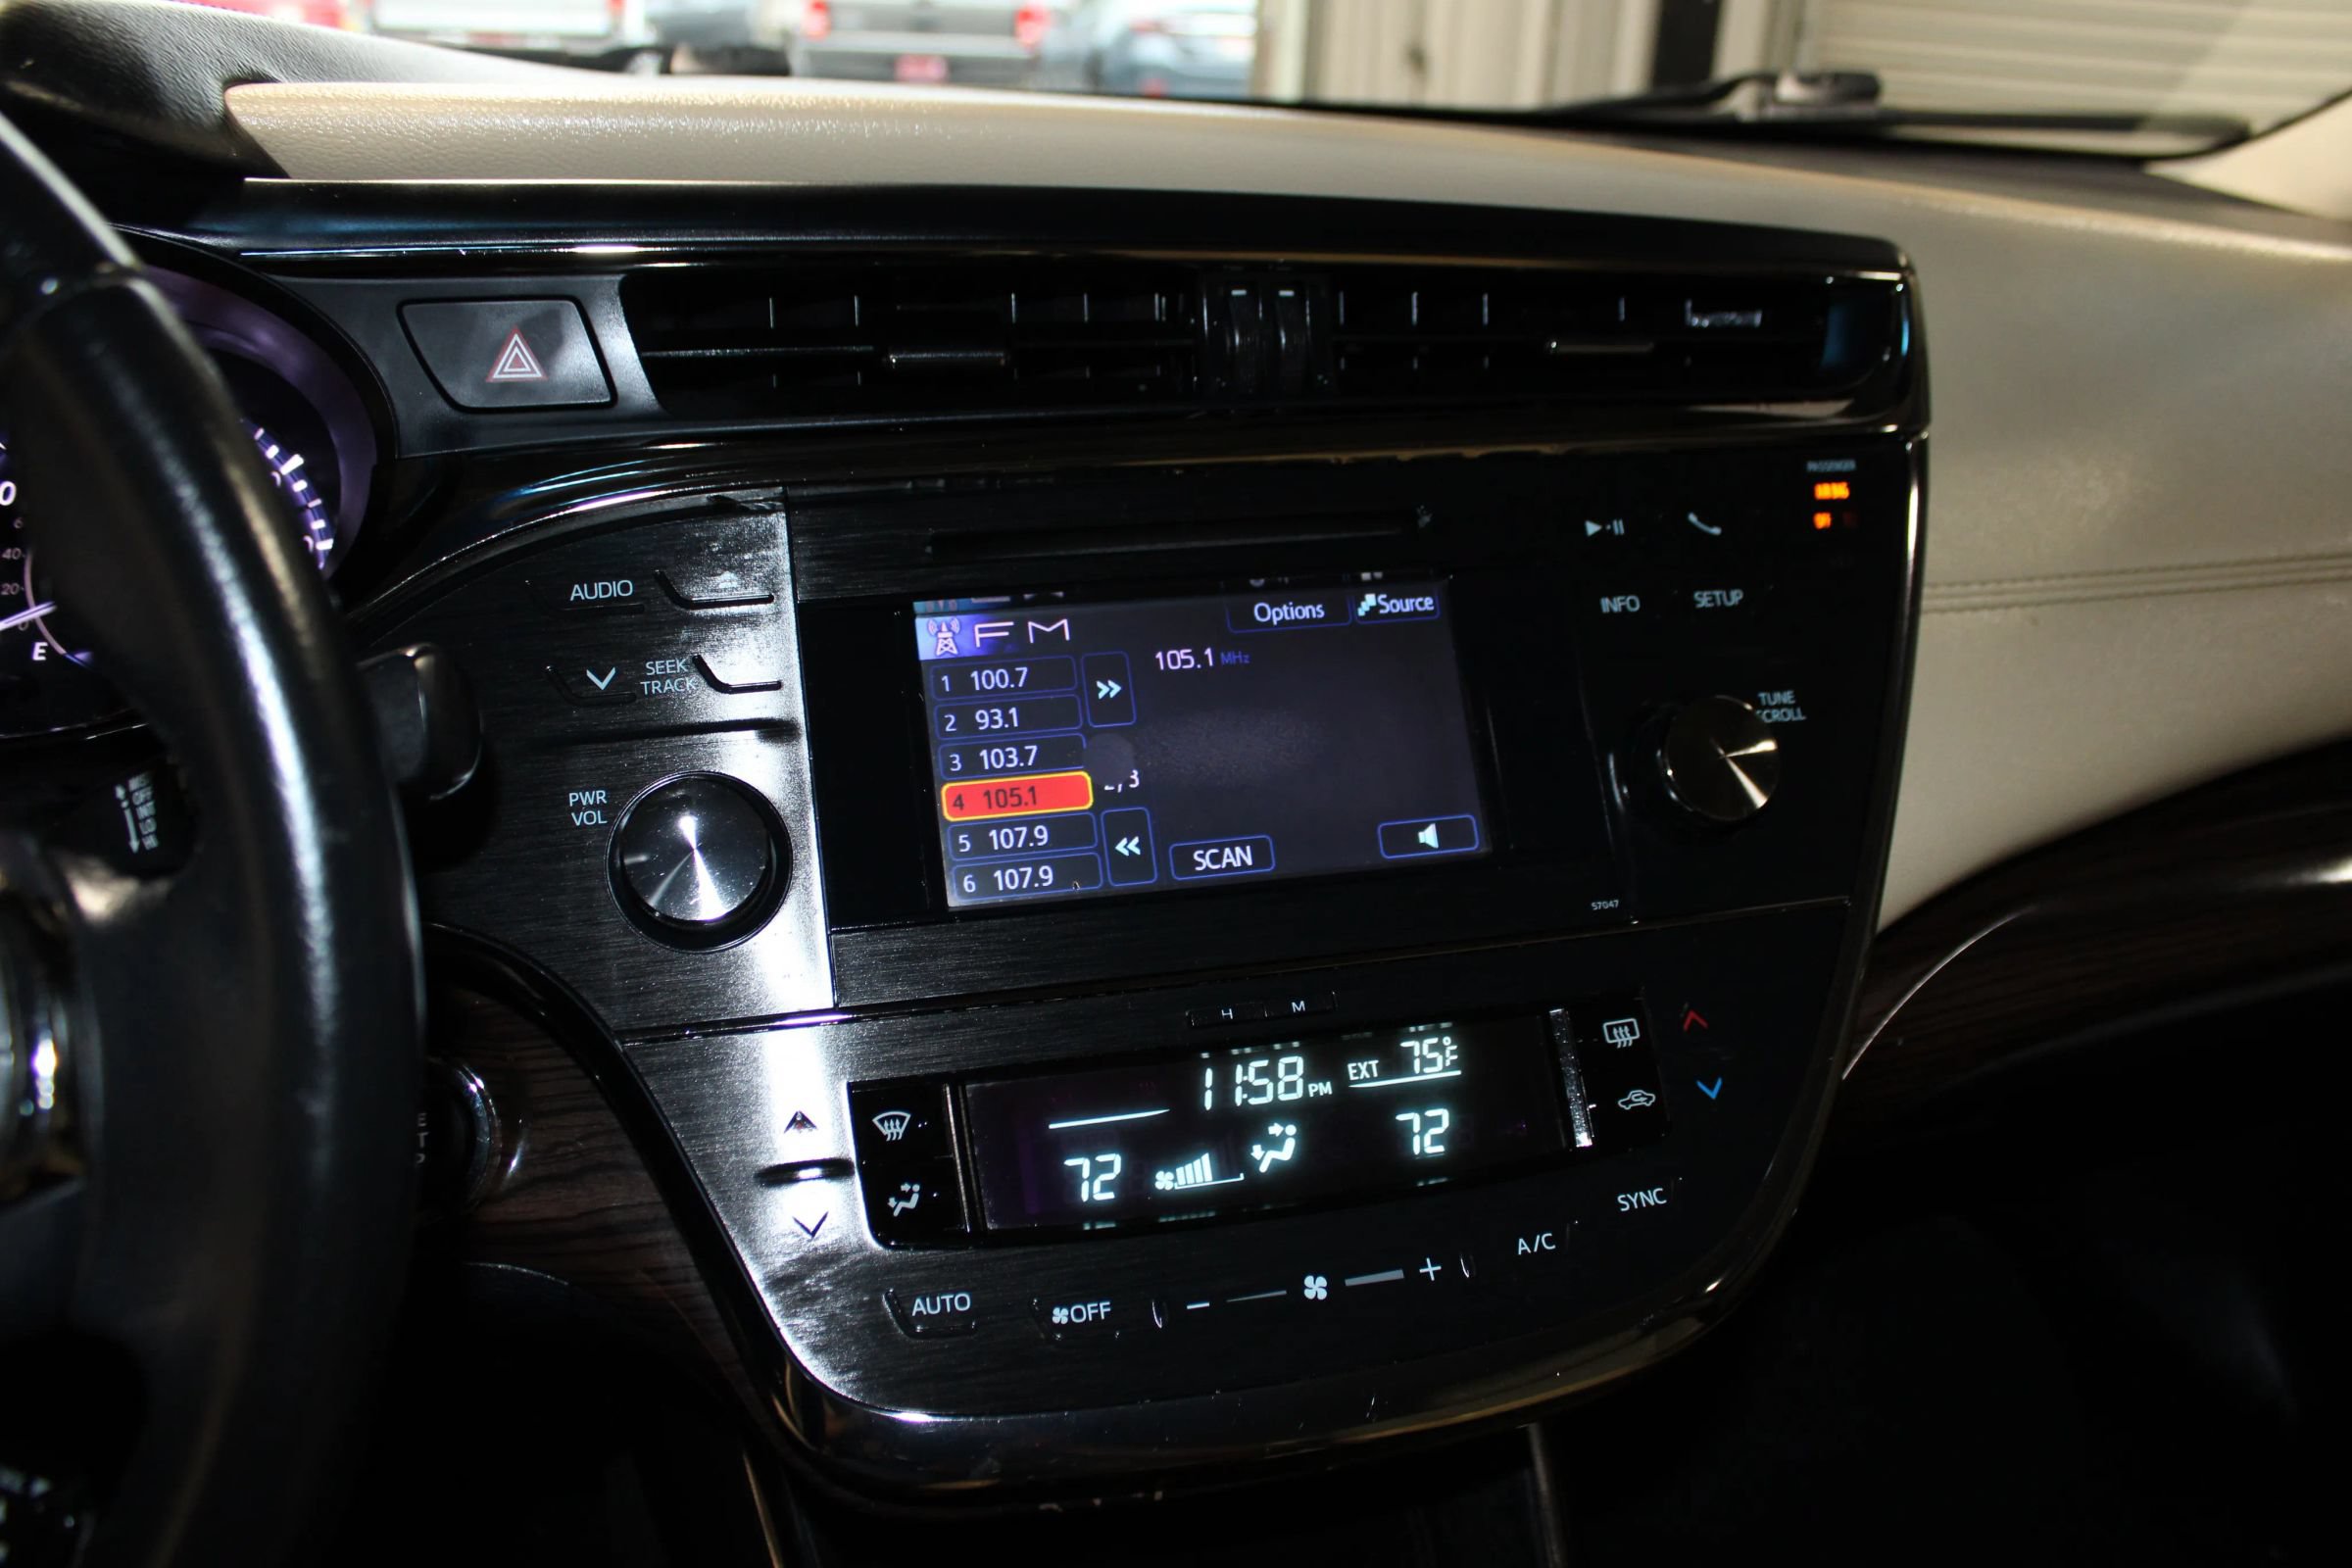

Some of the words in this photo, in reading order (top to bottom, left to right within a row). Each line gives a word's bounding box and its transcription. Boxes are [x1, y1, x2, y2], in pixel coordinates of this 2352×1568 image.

[569, 578, 634, 602] AUDIO
[1693, 589, 1744, 609] SETUP
[1253, 602, 1325, 625] Options
[1377, 593, 1435, 613] Source
[1599, 594, 1641, 613] INFO
[32, 641, 49, 662] E
[1154, 647, 1215, 671] 105.1
[1220, 652, 1250, 665] MHz
[645, 659, 688, 676] SEEK
[640, 677, 697, 696] TRACK
[941, 674, 951, 693] 1
[969, 666, 1029, 693] 100.7
[1757, 690, 1796, 707] TUNE
[944, 714, 957, 733] 2
[974, 707, 1020, 731] 93.1
[949, 754, 962, 772] 3
[979, 745, 1039, 770] 103.7
[568, 790, 608, 808] PWR
[953, 793, 965, 810] 4
[983, 786, 1039, 810] 105.1
[570, 809, 608, 826] VOL
[957, 835, 972, 853] 5
[989, 825, 1050, 852] 107.9
[1193, 845, 1253, 870] SCAN
[962, 874, 977, 893] 6
[993, 865, 1054, 892] 107.9
[1591, 899, 1619, 910] 57047
[1221, 1007, 1234, 1020] H
[1292, 1001, 1305, 1012] M
[1348, 1059, 1379, 1081] EXT
[1307, 1081, 1333, 1099] PM
[1396, 1107, 1449, 1156] 72
[1063, 1152, 1121, 1203] 72
[1617, 1188, 1667, 1211] SYNC
[1517, 1233, 1556, 1255] A/C
[911, 1293, 971, 1317] AUTO
[1070, 1301, 1111, 1324] OFF
